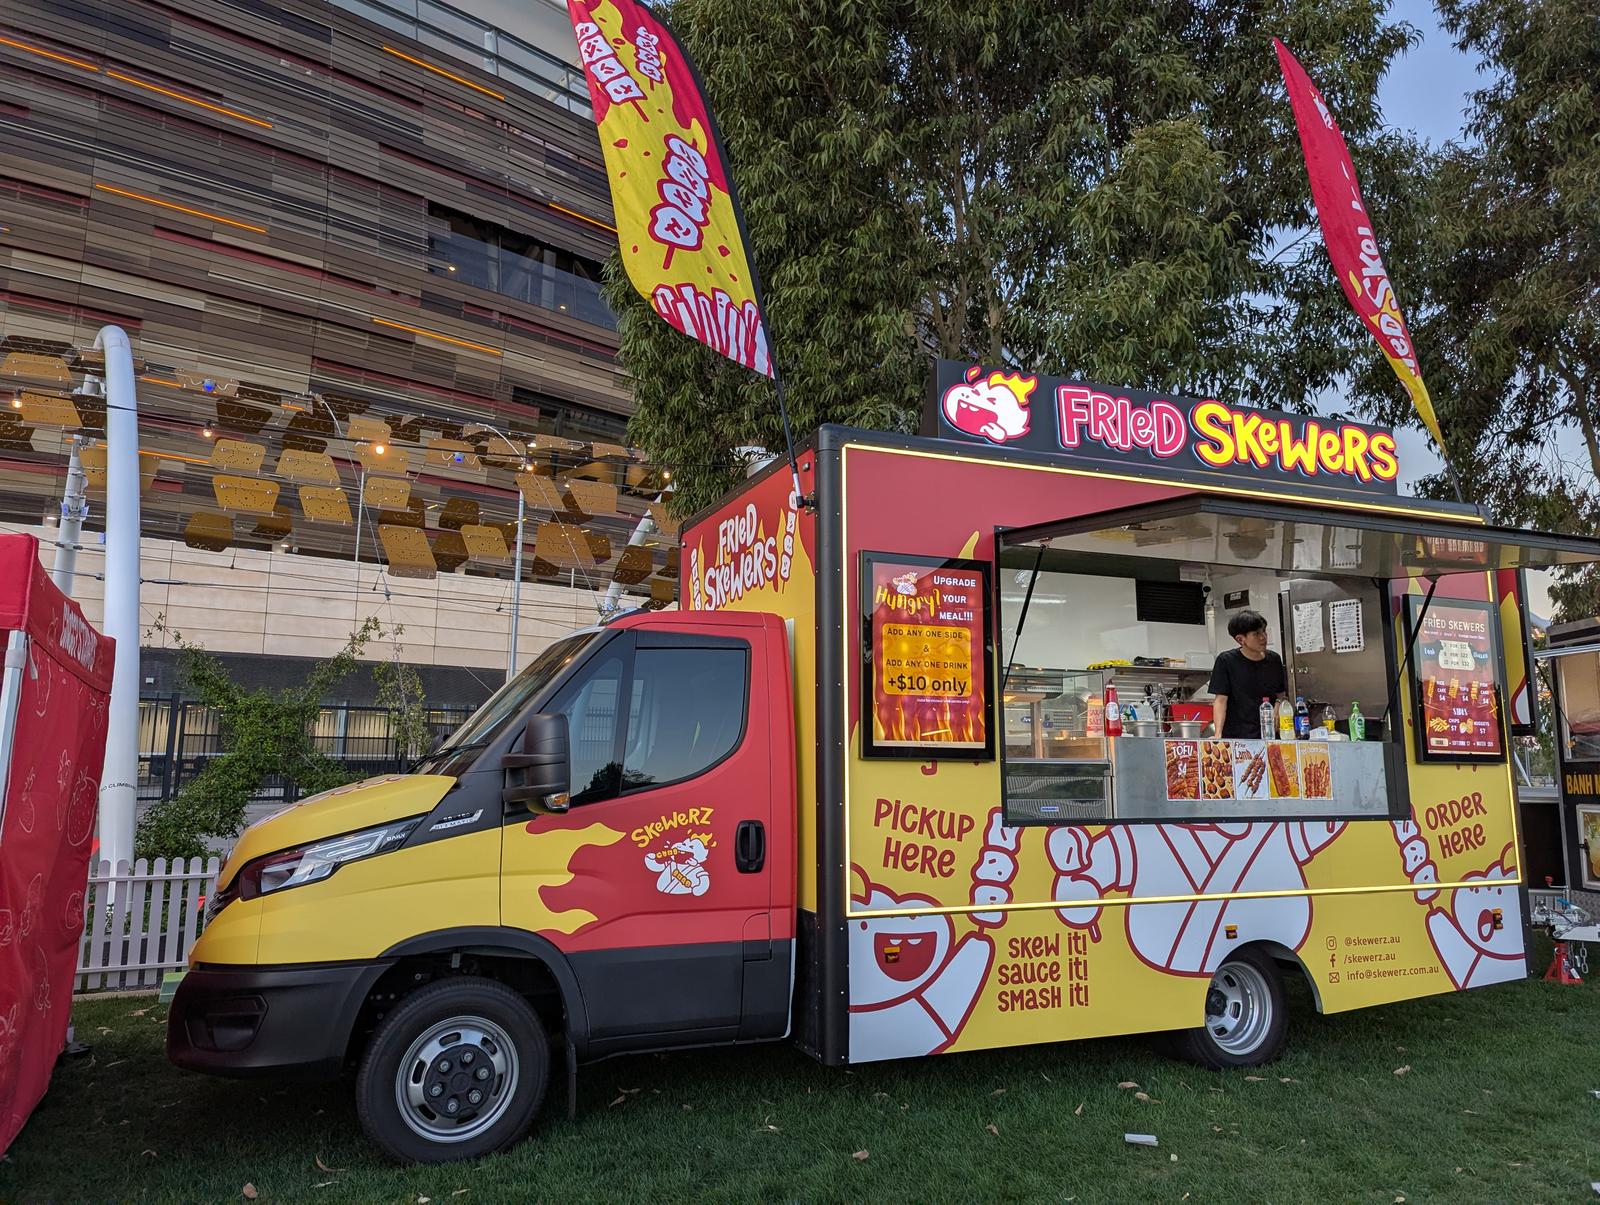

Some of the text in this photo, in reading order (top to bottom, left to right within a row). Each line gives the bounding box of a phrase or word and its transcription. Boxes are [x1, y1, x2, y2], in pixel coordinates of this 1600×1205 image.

[933, 575, 976, 587] UPGRADE
[875, 585, 941, 618] Hungry?
[943, 594, 967, 604] YOUR
[940, 612, 973, 621] MEAL!!!
[887, 628, 904, 636] ADD
[1423, 617, 1485, 633] FRIED SKEWERS
[923, 644, 929, 653] &
[888, 673, 967, 695] +$10 only
[1171, 745, 1193, 758] TOFU
[1566, 772, 1592, 795] BÁNH
[1425, 791, 1488, 831] ORDeR
[874, 798, 975, 842] PICKUP
[386, 832, 406, 842] DAILY
[1438, 823, 1487, 859] HeRe
[882, 836, 956, 878] HeRe
[1067, 931, 1087, 956] it!
[1344, 935, 1401, 947] @skewerz.au
[1343, 952, 1396, 965] /skewerz.au
[1068, 957, 1088, 981] it!
[1346, 965, 1439, 981] info@skewerz.com.au
[1069, 983, 1089, 1007] it!
